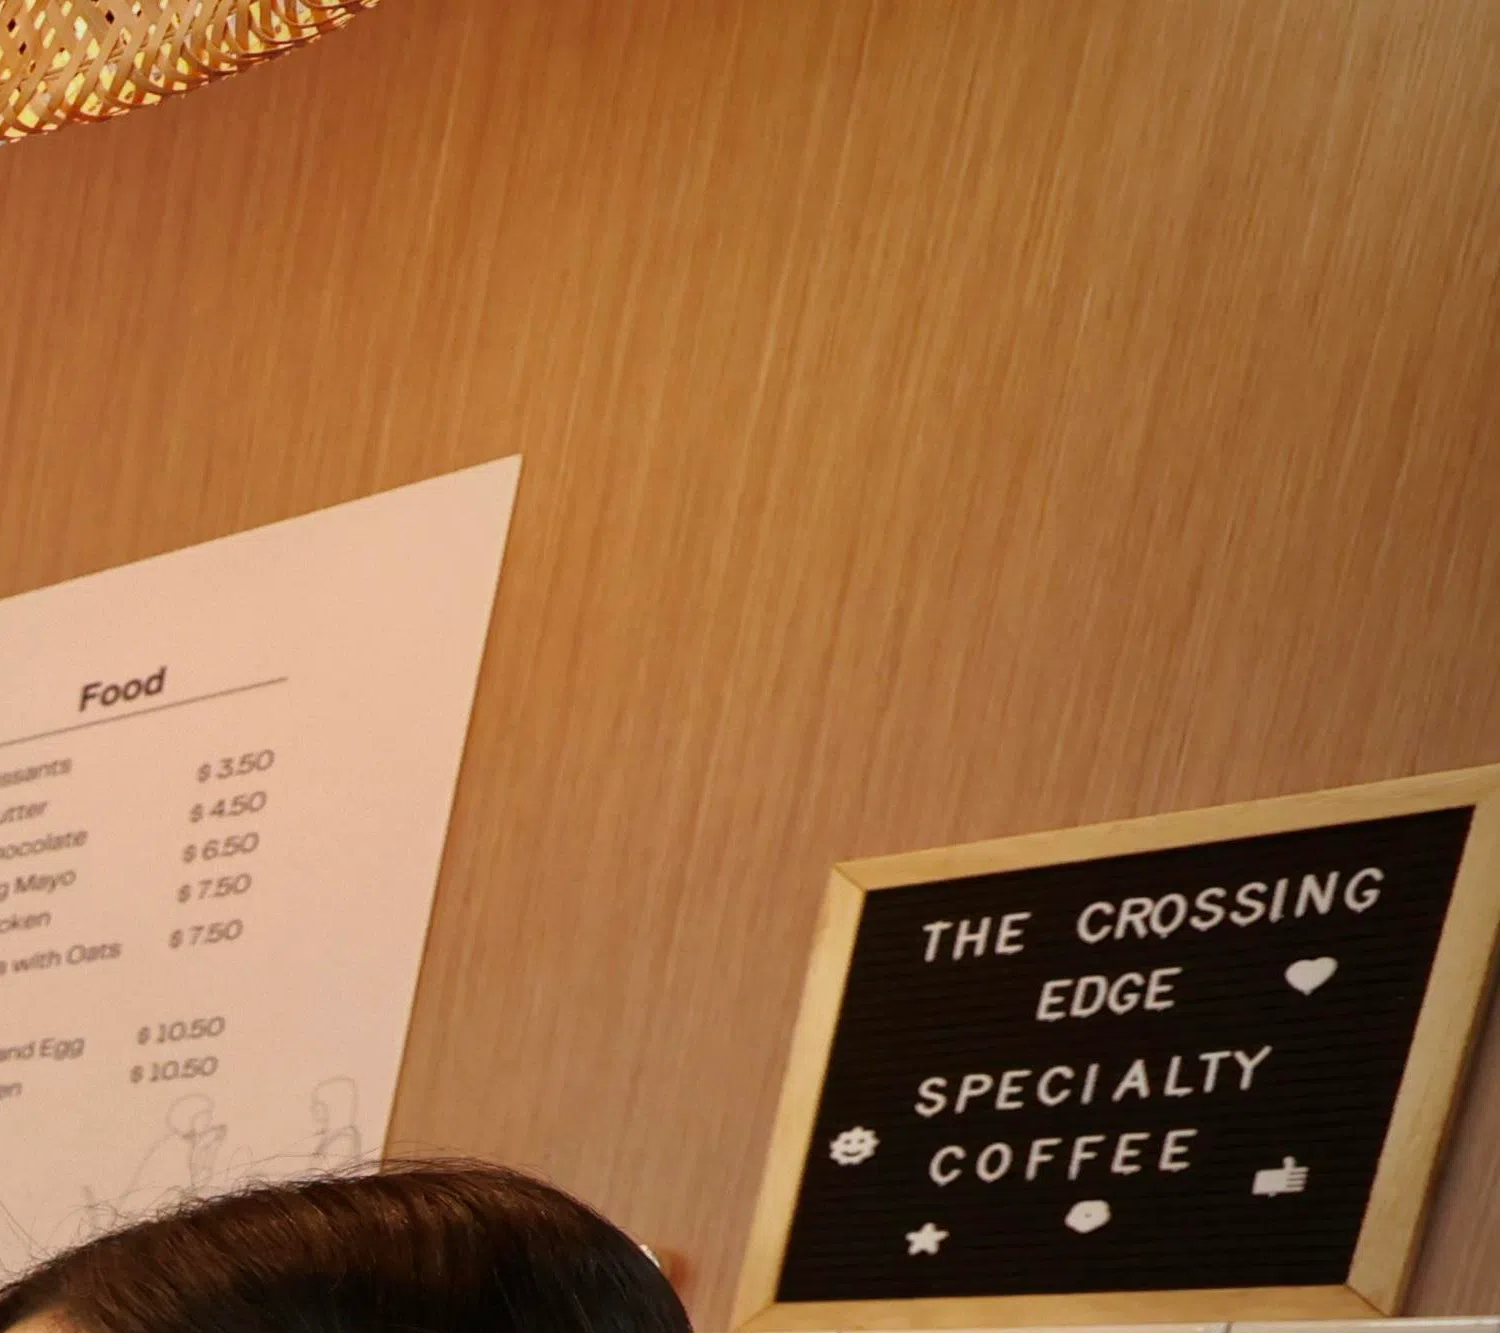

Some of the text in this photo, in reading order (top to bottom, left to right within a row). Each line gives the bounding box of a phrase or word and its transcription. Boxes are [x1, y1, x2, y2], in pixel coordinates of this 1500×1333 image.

[78, 666, 167, 712] Food
[15, 869, 77, 895] Mayo
[923, 868, 1386, 964] THE CROSSING
[11, 948, 61, 974] with
[65, 941, 122, 964] Oats
[1035, 966, 1183, 1022] EDGE
[40, 1036, 86, 1061] Egg
[914, 1045, 1272, 1117] SPECIALTY
[929, 1128, 1199, 1187] COFFEE
